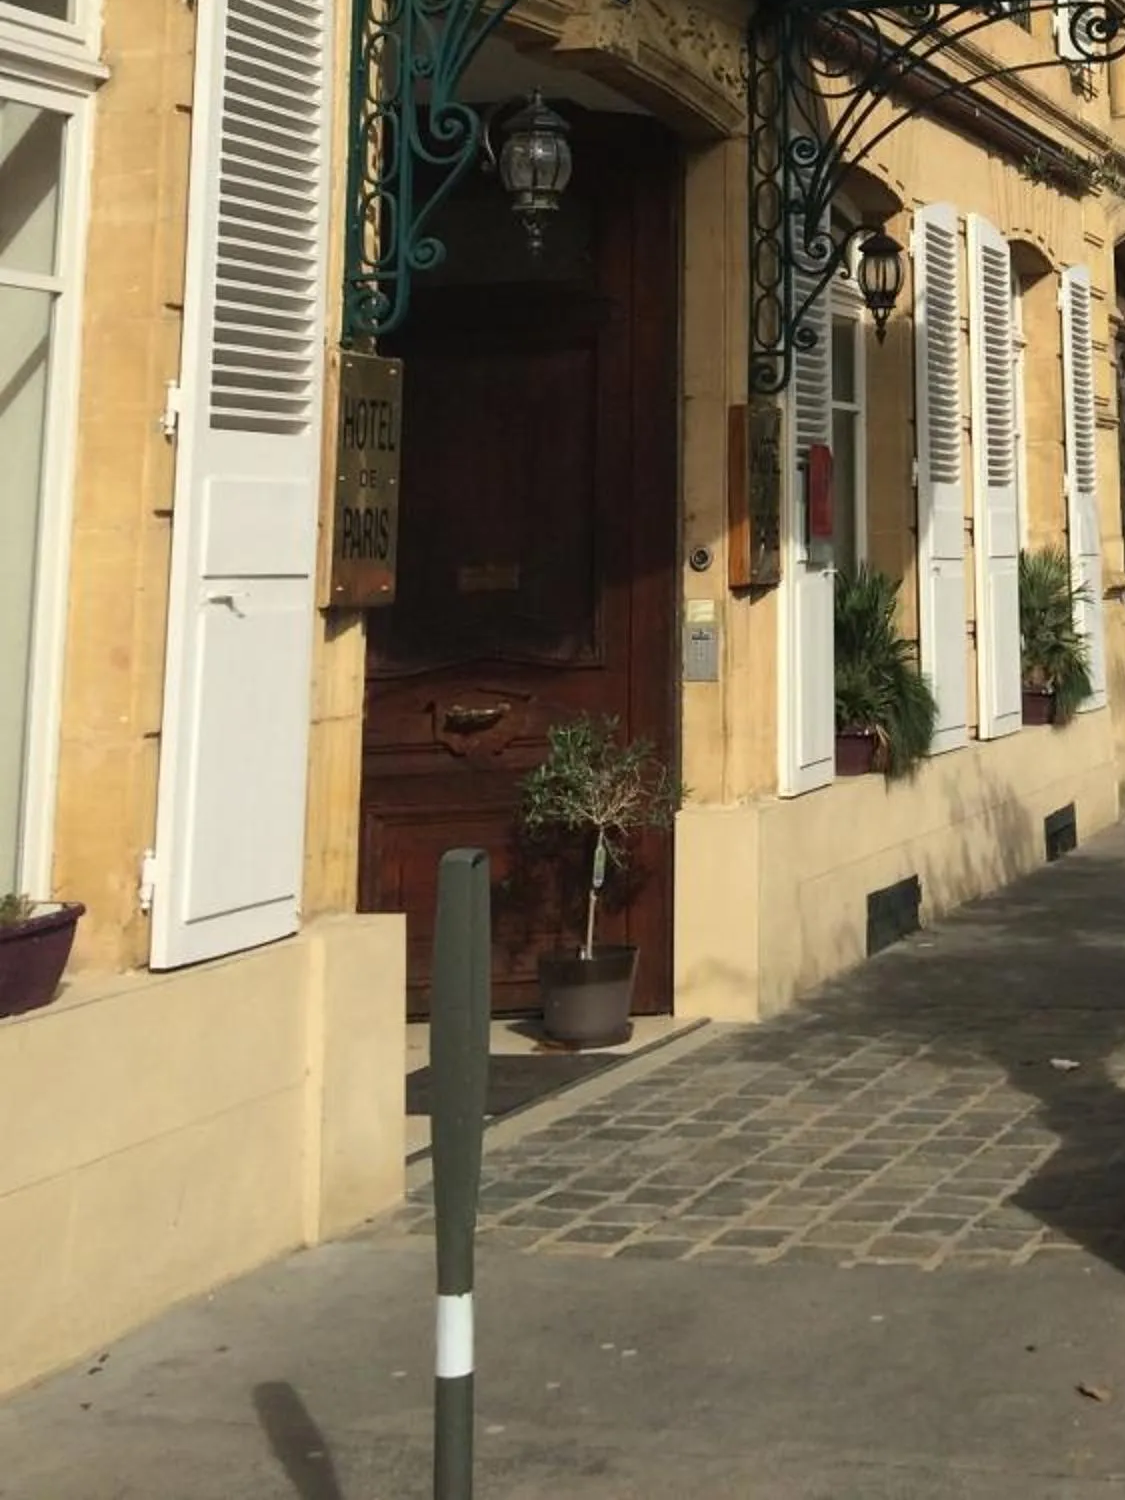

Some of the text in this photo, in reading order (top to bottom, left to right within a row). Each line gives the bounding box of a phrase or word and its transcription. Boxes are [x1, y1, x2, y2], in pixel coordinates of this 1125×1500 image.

[343, 397, 395, 451] HOTEL
[360, 469, 377, 488] DE
[342, 508, 390, 560] PARIS
